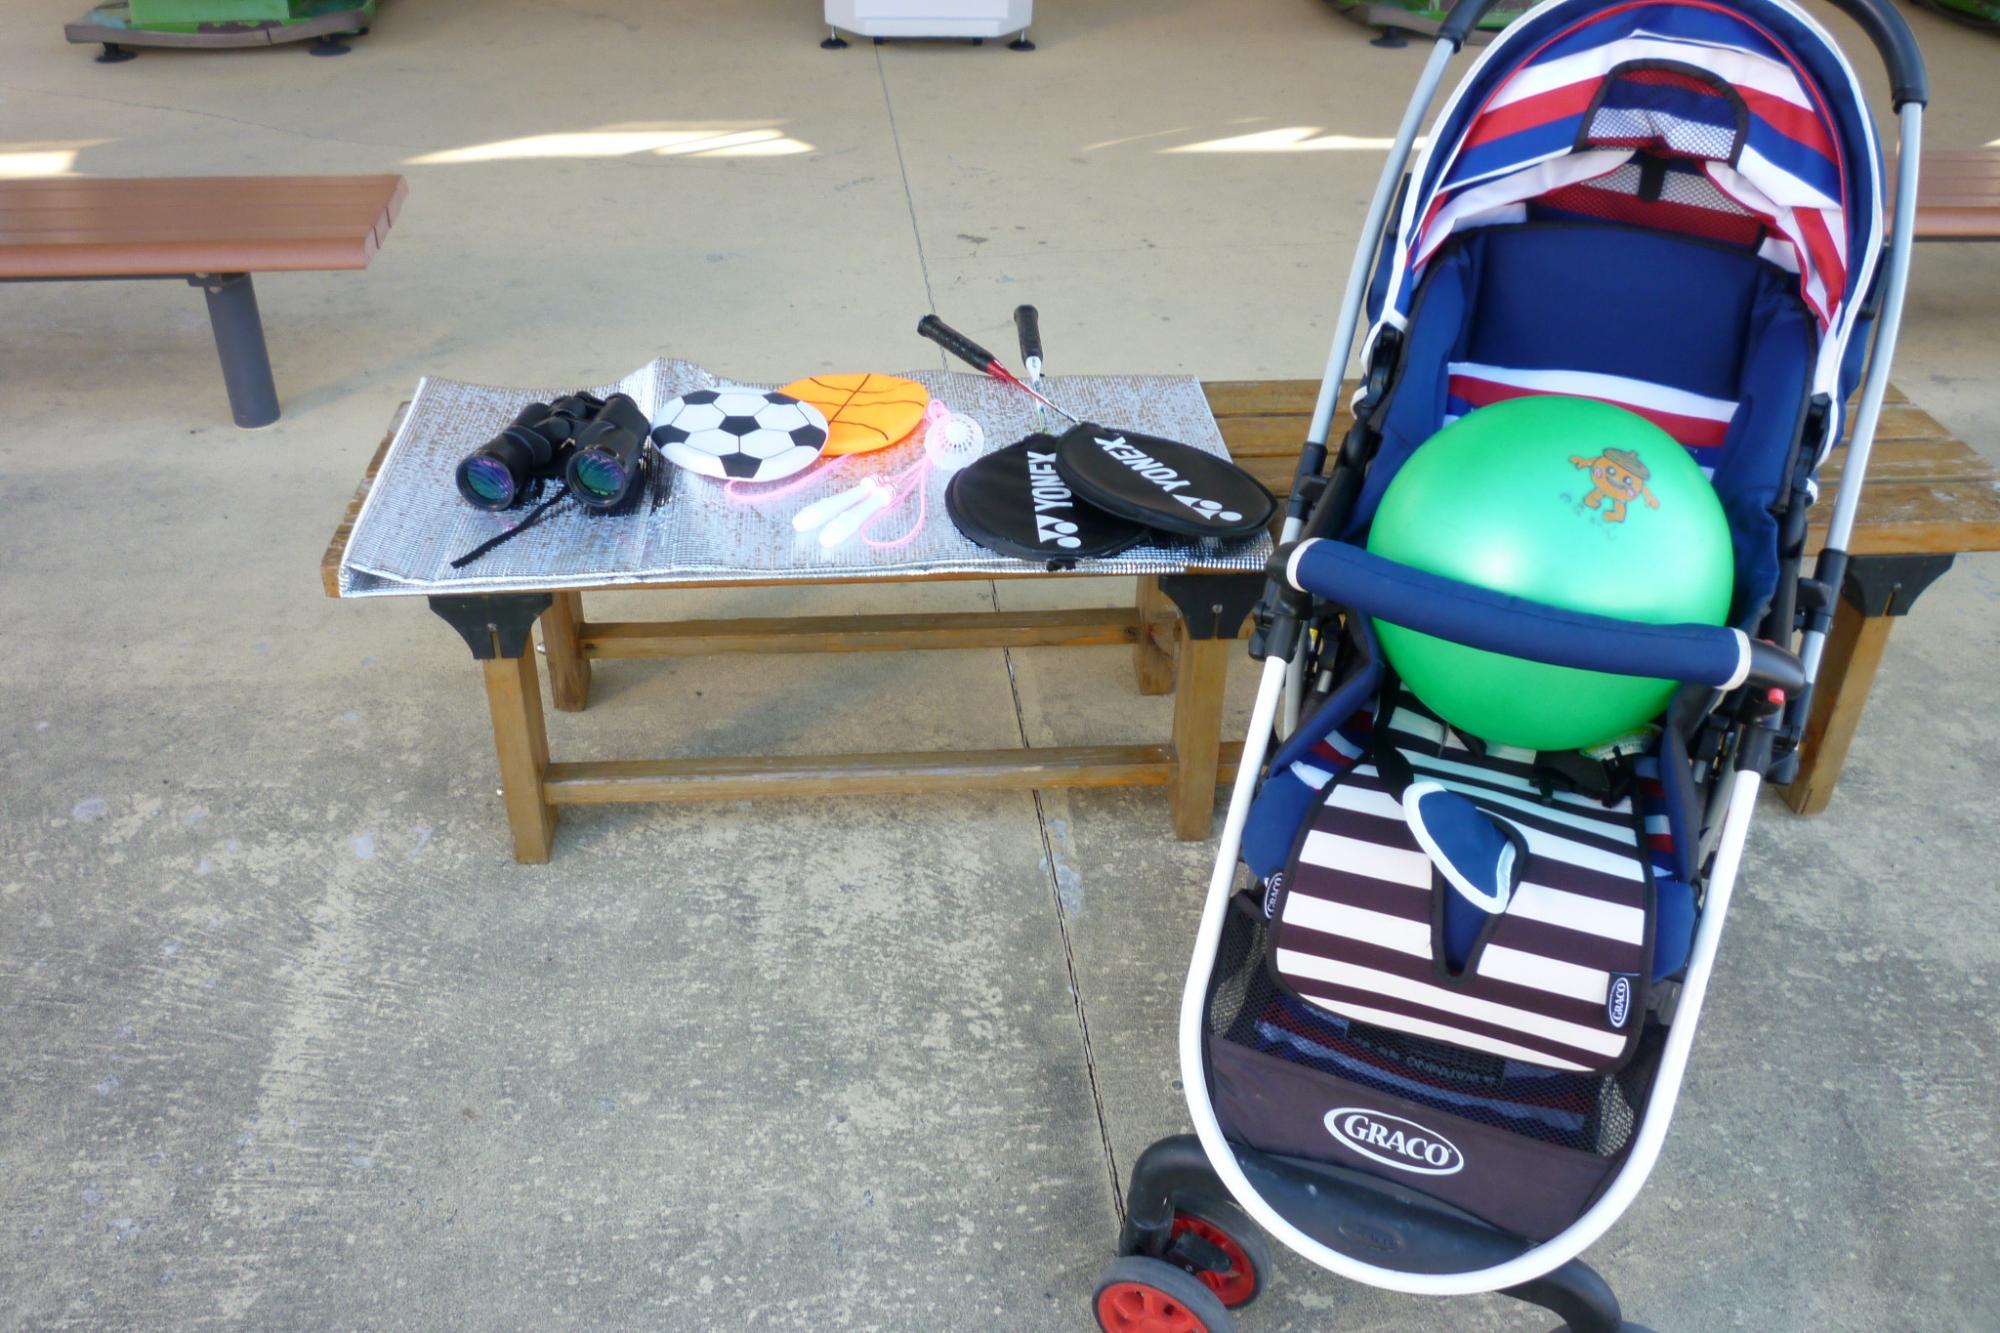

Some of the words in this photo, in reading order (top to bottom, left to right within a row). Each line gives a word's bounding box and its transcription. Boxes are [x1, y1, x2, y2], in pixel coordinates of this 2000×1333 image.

[1027, 451, 1073, 512] YONEX
[1094, 436, 1191, 492] YONEX
[1267, 877, 1282, 912] GRACO
[1612, 982, 1626, 1021] GRACO
[1344, 1114, 1450, 1166] GRACO
